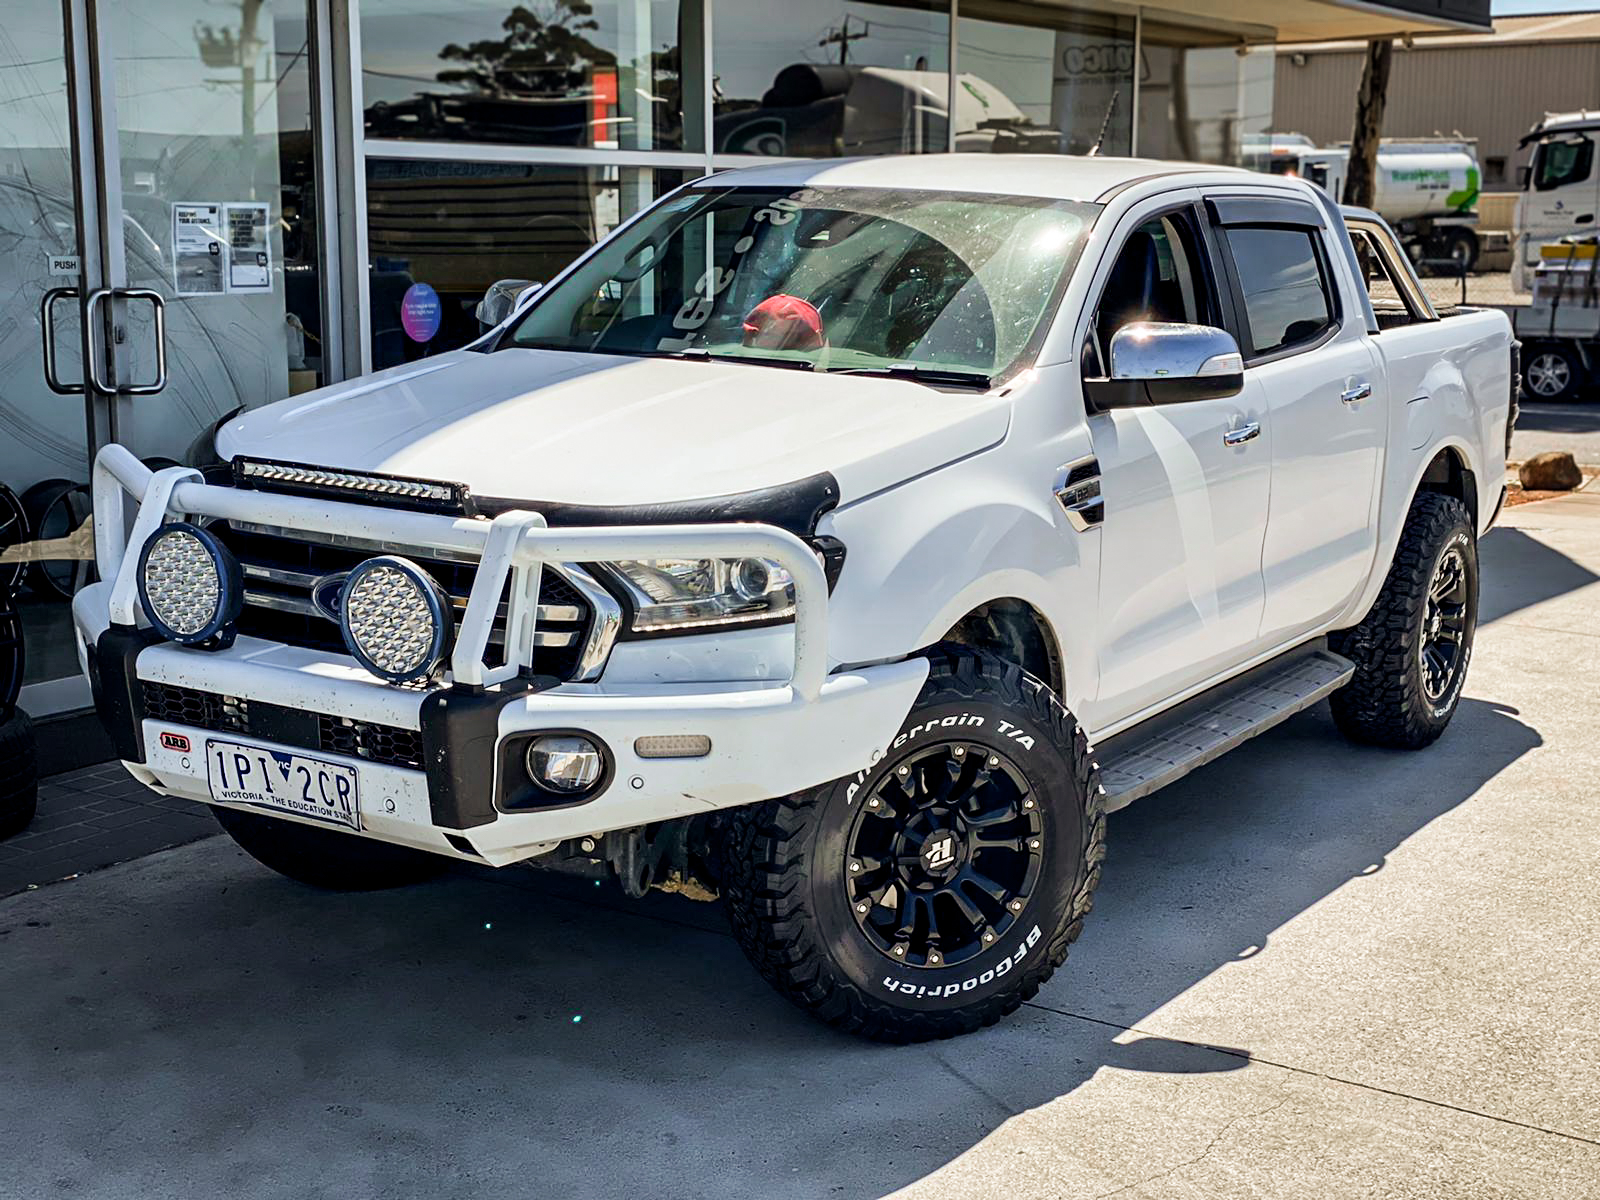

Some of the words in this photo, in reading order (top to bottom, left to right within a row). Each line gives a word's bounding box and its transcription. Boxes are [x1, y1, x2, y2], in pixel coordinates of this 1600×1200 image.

[54, 260, 77, 270] PUSH
[164, 735, 188, 749] ARB
[997, 720, 1036, 751] T/A
[277, 760, 291, 770] VIC
[221, 790, 265, 801] VICTORIA
[270, 795, 287, 807] THE
[288, 801, 333, 816] EDUCATION
[882, 924, 1043, 999] BFGoodrich
